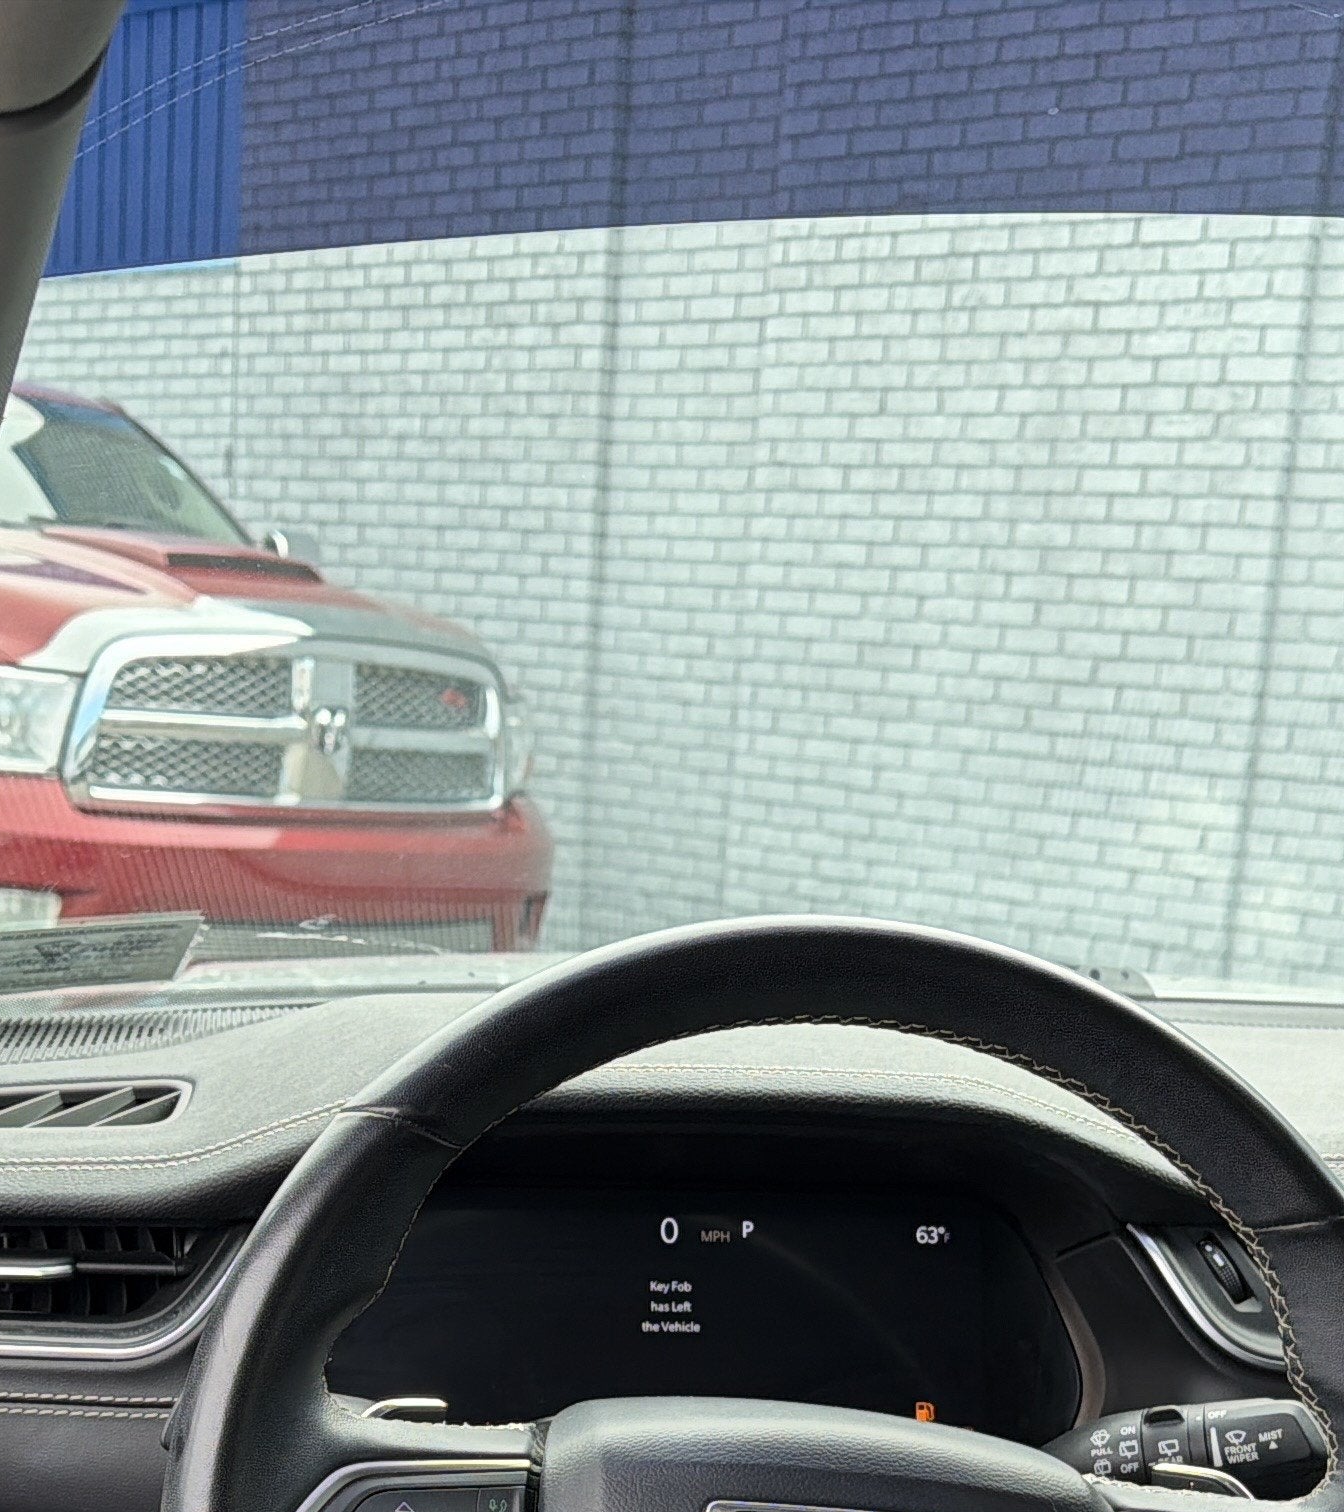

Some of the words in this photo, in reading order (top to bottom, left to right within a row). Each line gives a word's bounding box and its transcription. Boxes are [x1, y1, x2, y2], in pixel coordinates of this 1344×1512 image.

[660, 1217, 679, 1244] 0
[700, 1230, 731, 1243] MPH
[742, 1220, 755, 1239] P
[649, 1280, 670, 1295] Key
[671, 1280, 693, 1293] Fob
[650, 1300, 670, 1313] has
[671, 1300, 693, 1313] Left
[641, 1320, 660, 1333] the
[661, 1320, 701, 1333] Vehicle
[1207, 1409, 1228, 1420] OFF
[1119, 1425, 1137, 1436] ON
[1258, 1428, 1283, 1443] MIST
[1090, 1446, 1114, 1457] PULL
[1223, 1443, 1257, 1456] FRONT
[1226, 1452, 1260, 1465] WIPER
[1119, 1461, 1141, 1474] OFF
